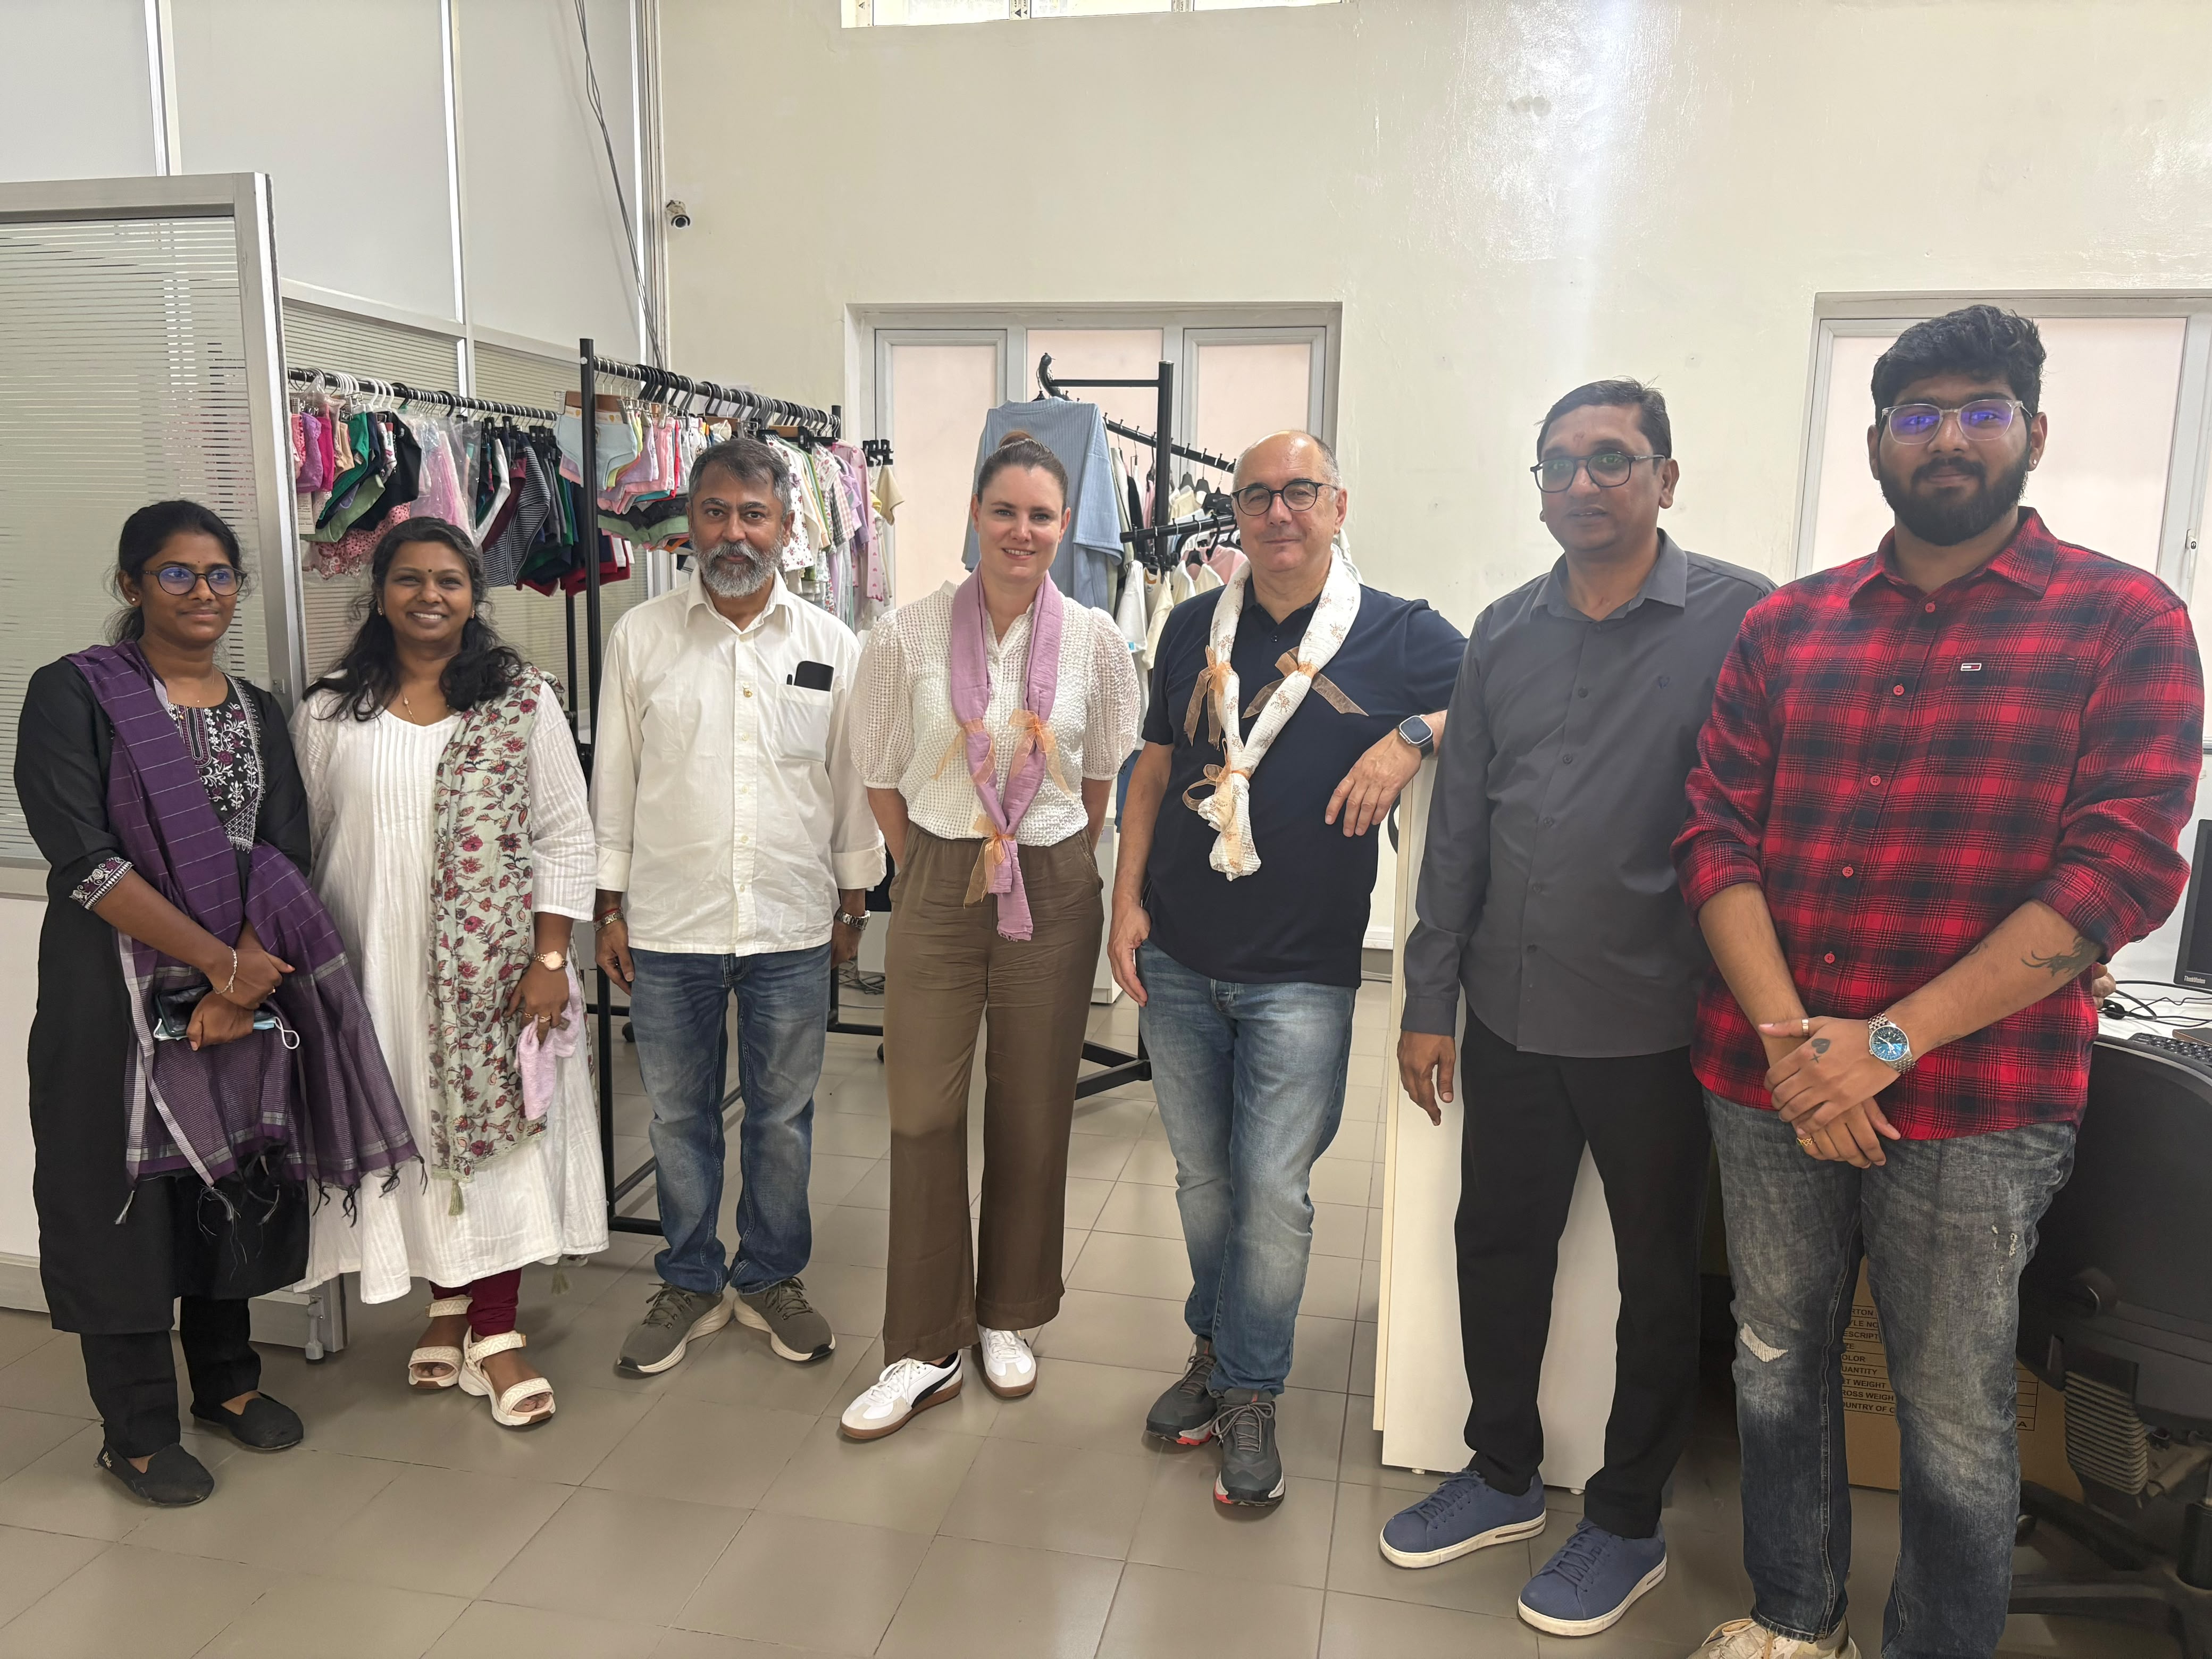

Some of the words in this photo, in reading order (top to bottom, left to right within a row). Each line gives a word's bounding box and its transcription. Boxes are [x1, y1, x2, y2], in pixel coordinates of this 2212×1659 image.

[1841, 1366, 1878, 1375] UANTITY
[1853, 1379, 1887, 1389] WEIGHT
[1866, 1392, 1894, 1401] WEIGH
